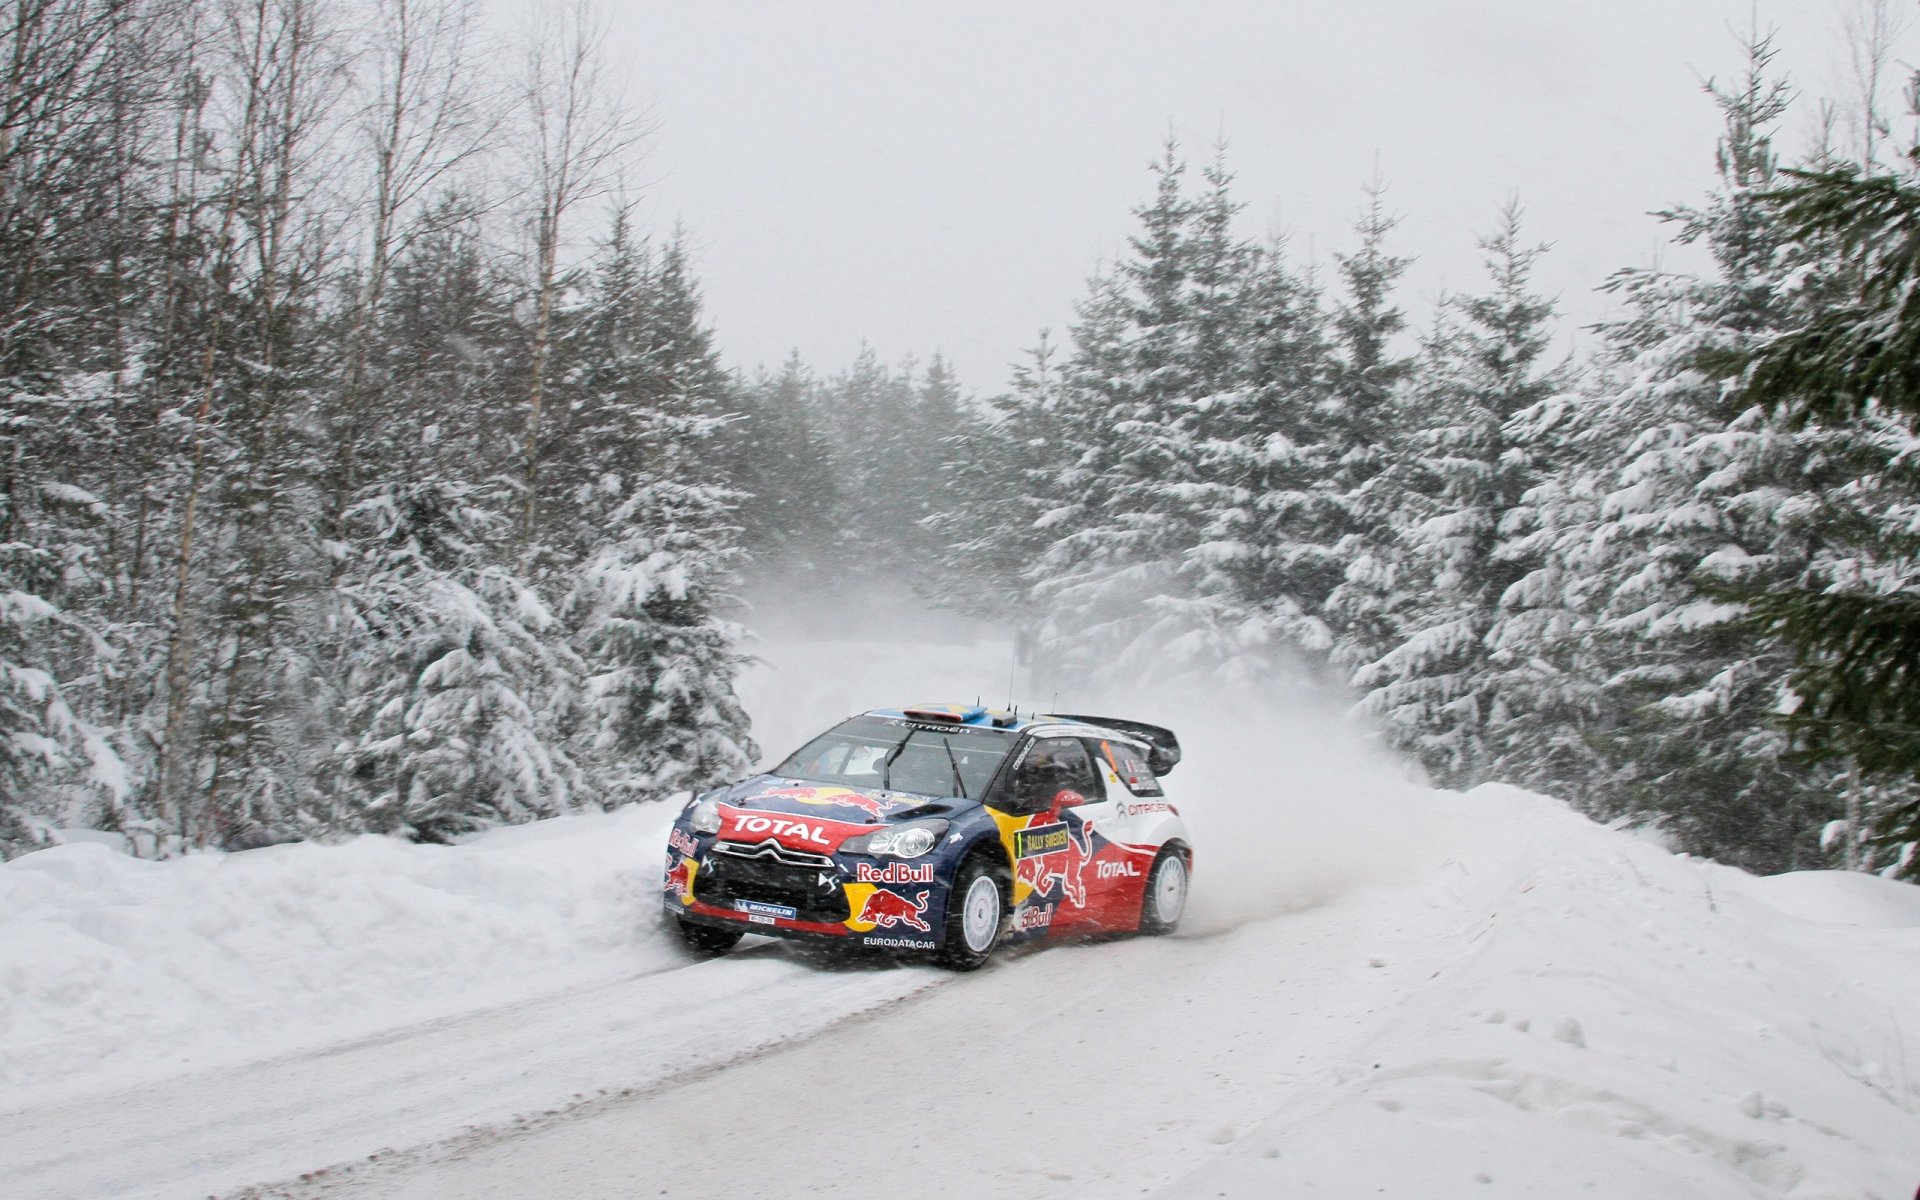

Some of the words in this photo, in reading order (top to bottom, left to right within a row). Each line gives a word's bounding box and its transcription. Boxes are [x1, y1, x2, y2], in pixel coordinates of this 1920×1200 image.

[734, 814, 831, 845] TOTAL
[1027, 834, 1044, 851] RALLY
[1096, 860, 1141, 879] TOTAL
[749, 904, 793, 916] MICHELIN
[863, 936, 936, 950] EURODATACAR
